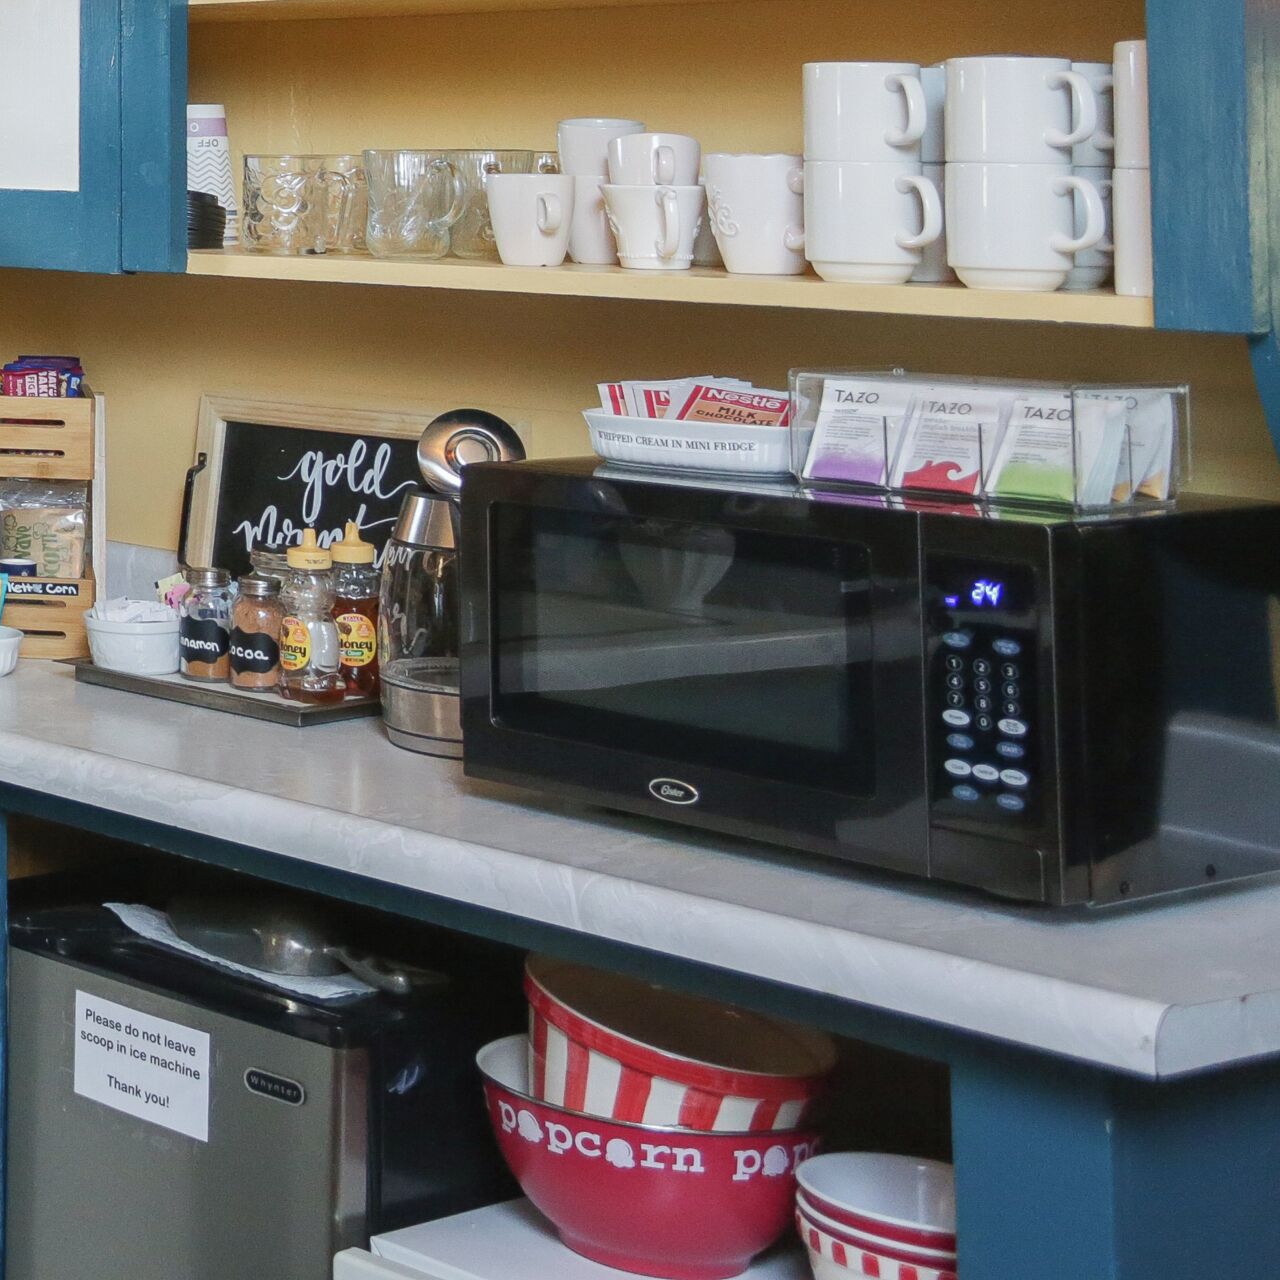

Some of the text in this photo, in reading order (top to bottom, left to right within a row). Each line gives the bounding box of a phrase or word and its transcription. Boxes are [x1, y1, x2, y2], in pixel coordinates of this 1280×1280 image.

[835, 389, 879, 404] TAZO
[696, 410, 773, 426] CHOCOLATE
[718, 406, 757, 419] MILK
[928, 401, 972, 416] TAZO
[1024, 406, 1072, 421] TAZO
[597, 430, 755, 452] WHIPPED CREAM IN MINI FRIDGE
[277, 439, 417, 523] gold
[46, 583, 77, 595] Corn
[85, 1008, 196, 1057] Please do not leave
[80, 1030, 201, 1080] scoop in ice machine
[107, 1073, 170, 1109] Thank you!
[250, 1075, 298, 1098] Whynter
